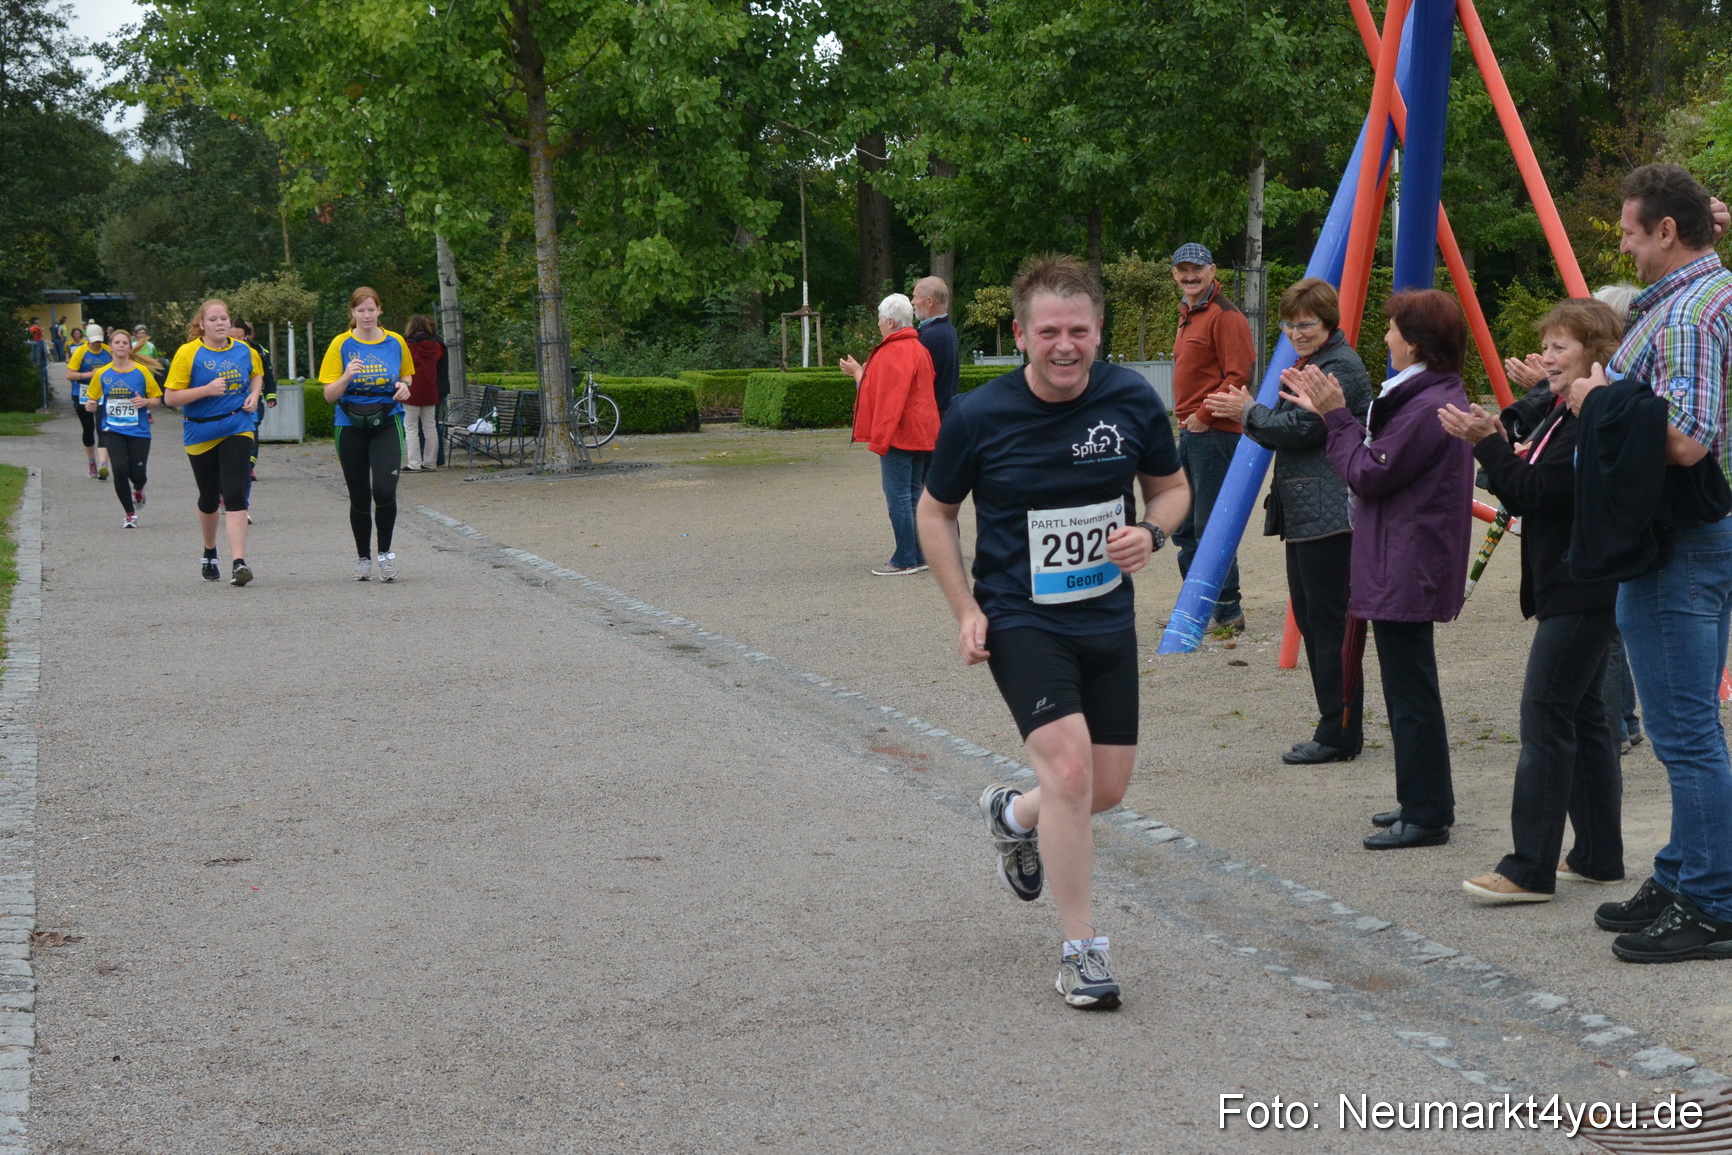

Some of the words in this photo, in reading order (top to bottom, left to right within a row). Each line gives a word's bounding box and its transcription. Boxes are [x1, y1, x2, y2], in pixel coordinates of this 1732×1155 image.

[109, 406, 135, 416] 2675
[1072, 442, 1106, 458] Spitz
[1031, 519, 1067, 530] PARTL
[1069, 511, 1113, 527] Neumarkt
[1066, 572, 1103, 588] Georg
